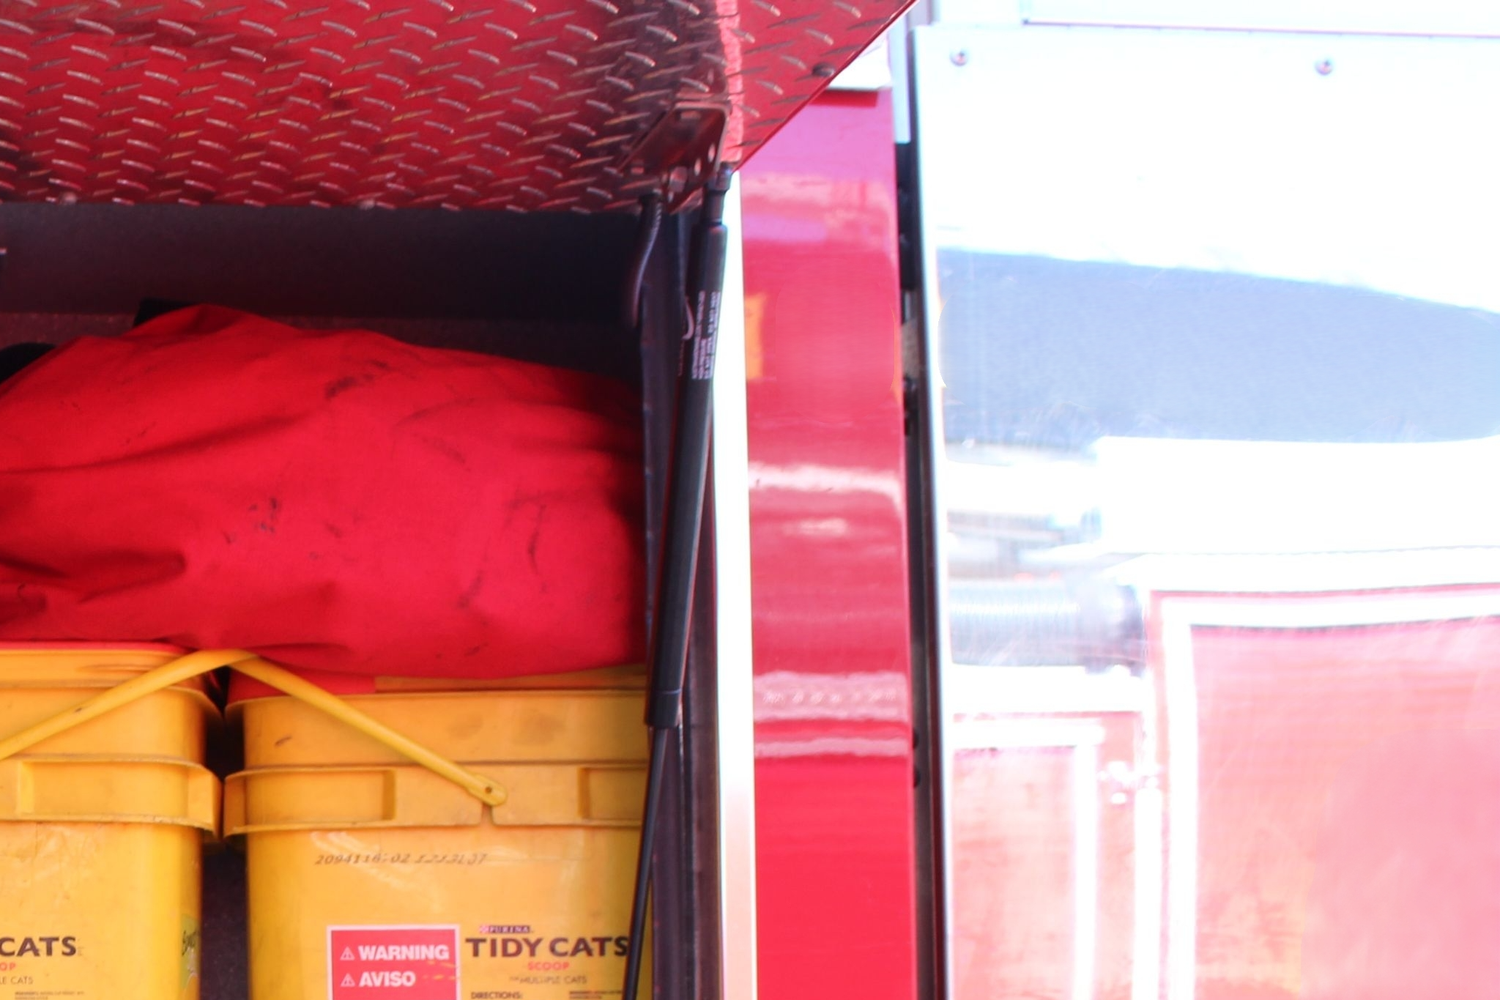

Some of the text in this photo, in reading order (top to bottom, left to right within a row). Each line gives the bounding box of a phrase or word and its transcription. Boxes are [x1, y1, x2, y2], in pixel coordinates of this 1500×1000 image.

[358, 945, 450, 961] WARNING
[466, 937, 628, 957] TIDY CATS
[528, 962, 570, 971] SCOOP
[10, 976, 33, 985] CATS
[358, 971, 416, 987] AVISO
[564, 976, 587, 984] CATS
